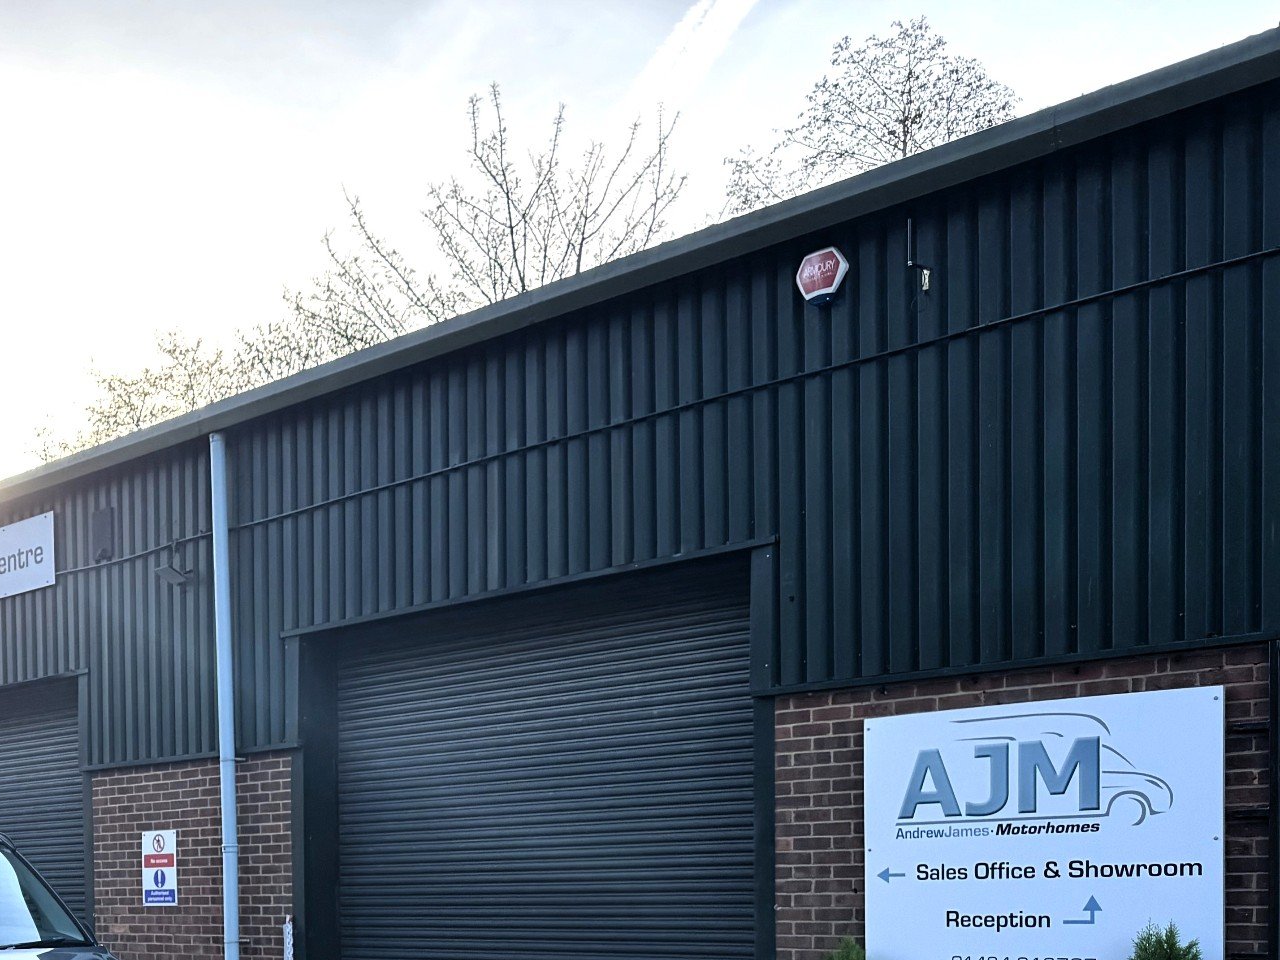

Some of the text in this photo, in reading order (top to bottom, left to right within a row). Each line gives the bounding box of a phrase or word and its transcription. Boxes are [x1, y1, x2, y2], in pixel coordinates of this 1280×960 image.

[897, 735, 1101, 820] AJM
[915, 859, 1204, 881] Sales Office & Showroom
[945, 910, 1052, 933] Reception
